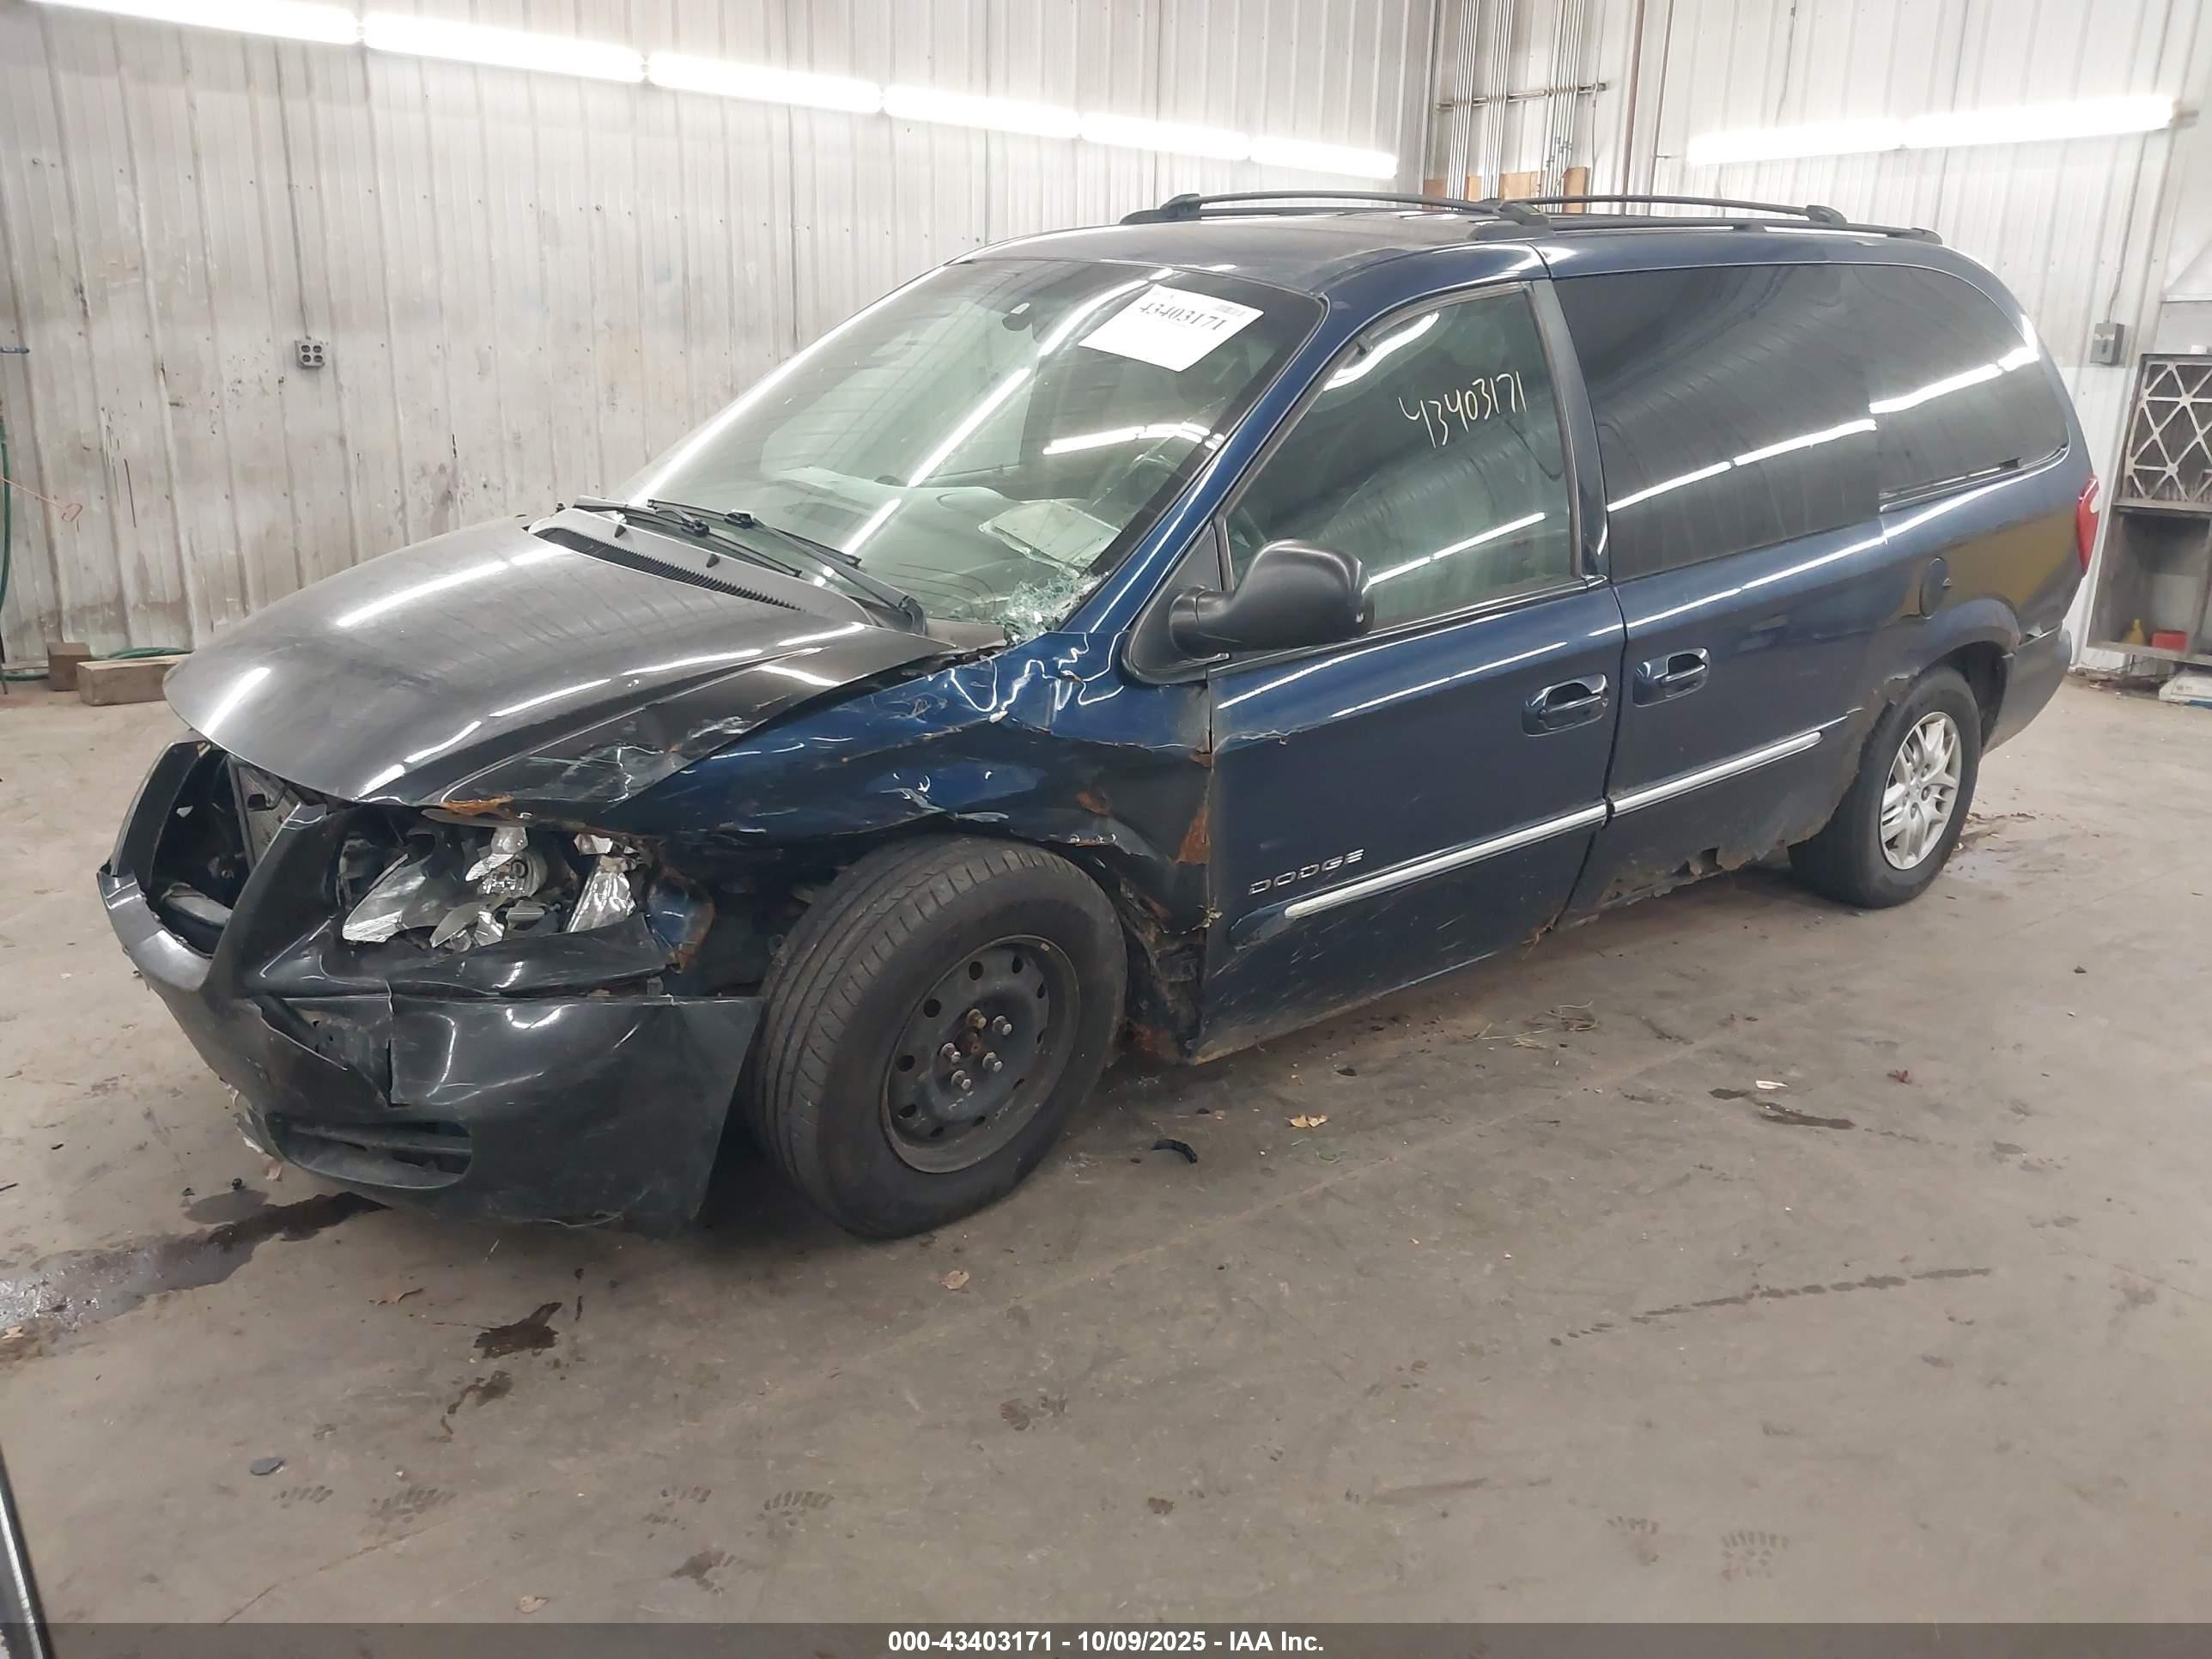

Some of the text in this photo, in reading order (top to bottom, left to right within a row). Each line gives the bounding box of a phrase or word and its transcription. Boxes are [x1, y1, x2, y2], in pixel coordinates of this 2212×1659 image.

[1139, 301, 1228, 331] 43403171
[1398, 371, 1528, 449] 43403171
[1248, 848, 1365, 895] DODGE
